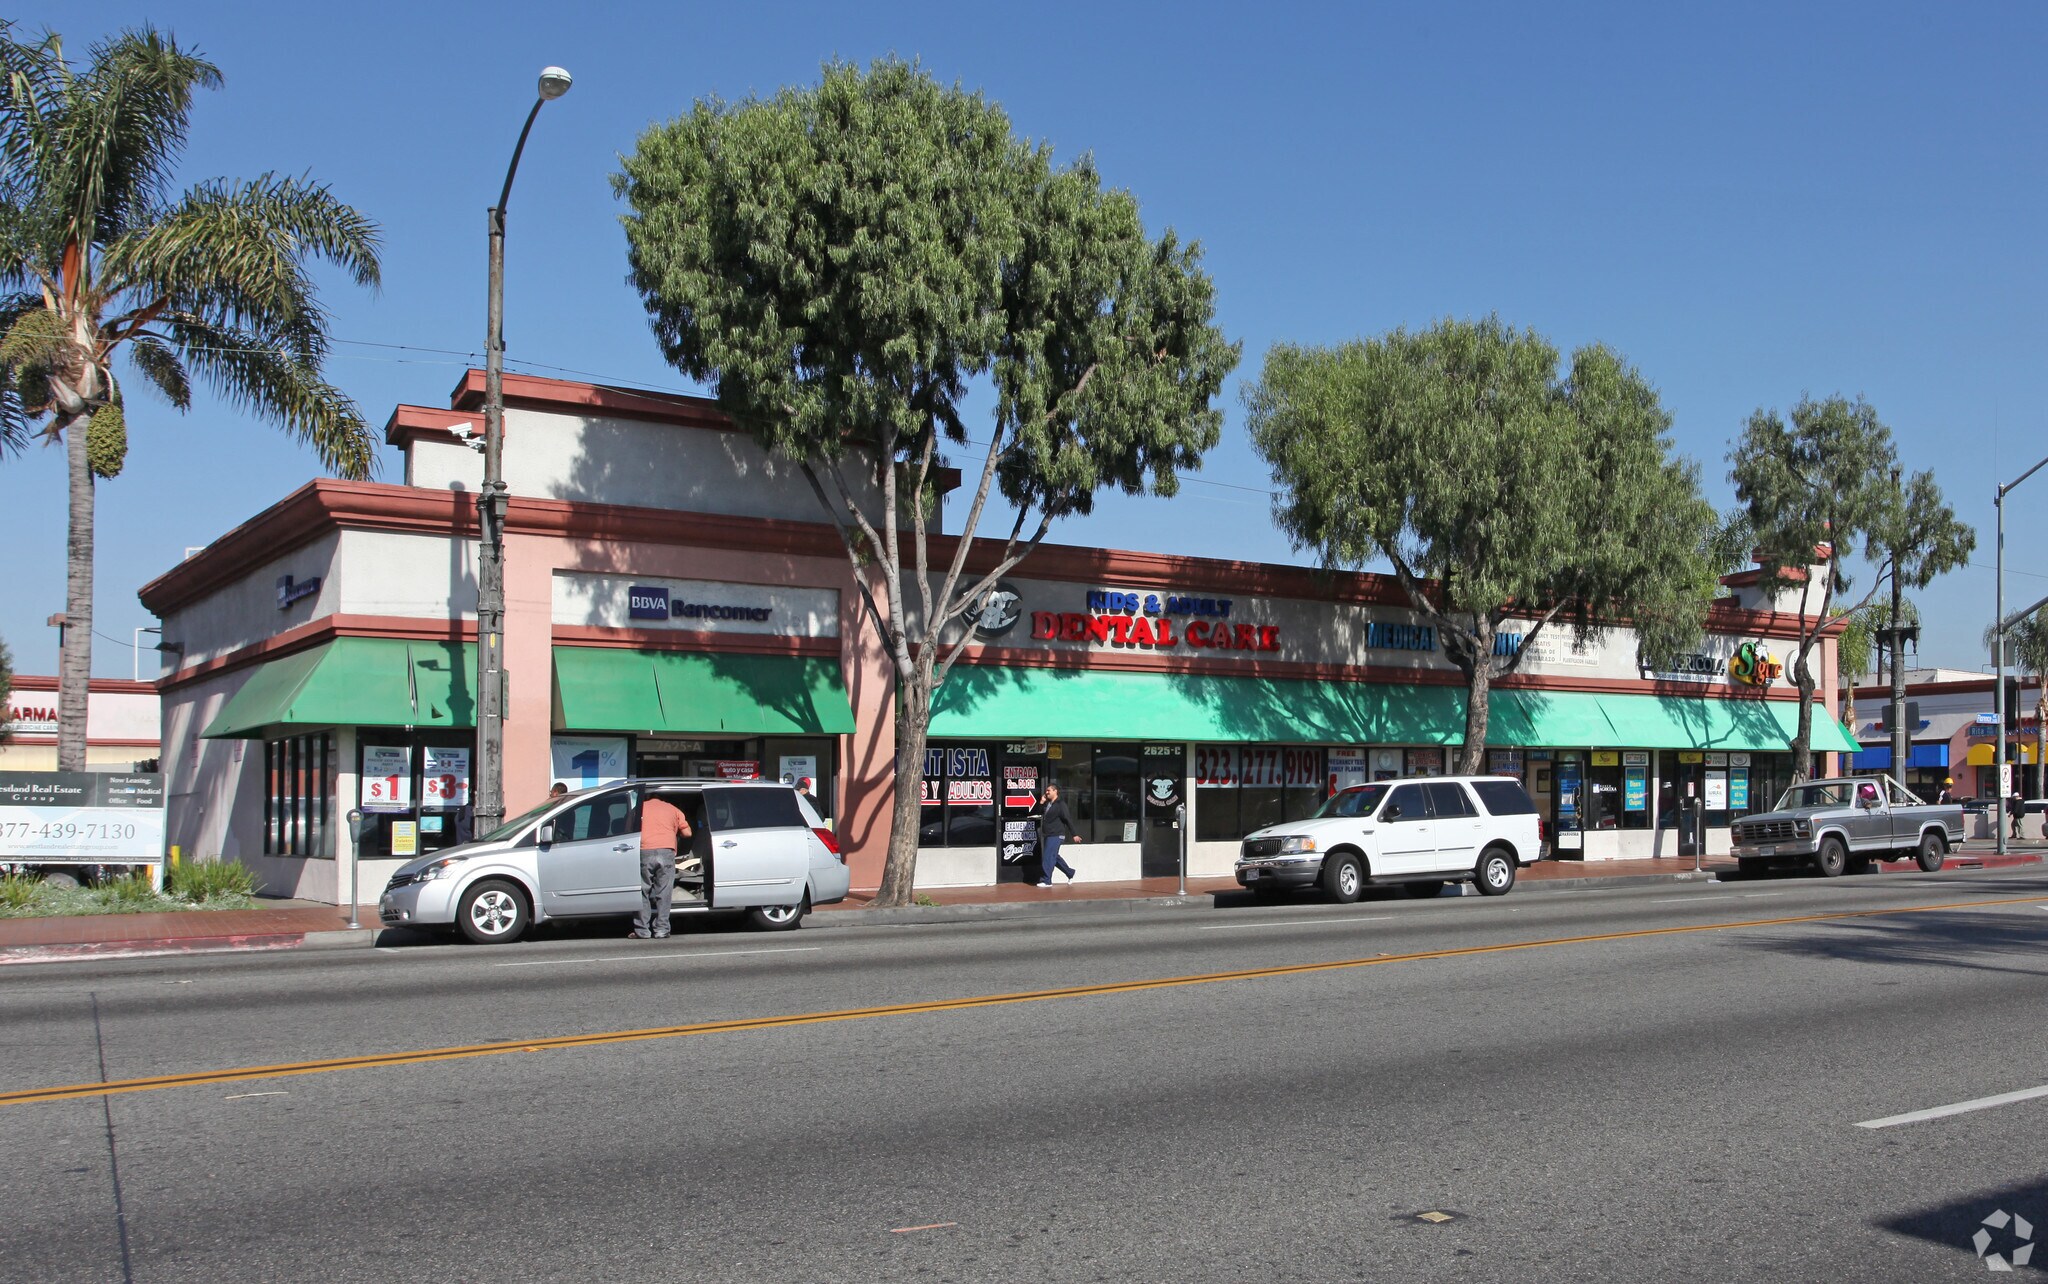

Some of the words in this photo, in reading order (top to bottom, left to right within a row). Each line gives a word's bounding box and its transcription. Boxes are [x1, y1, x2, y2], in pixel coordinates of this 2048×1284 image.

[632, 596, 667, 610] BBVA
[671, 600, 772, 621] Bancomer
[1087, 590, 1139, 612] KIDS
[1144, 594, 1161, 613] &
[1165, 597, 1232, 617] ADULT
[1031, 610, 1178, 646] DENTAL
[1185, 620, 1280, 651] CARE
[1367, 622, 1440, 652] MEDICAL
[1668, 654, 1729, 675] AGRICOLA
[1735, 642, 1783, 685] Sigue
[9, 707, 58, 721] ARMA
[1971, 727, 1985, 735] Rita
[656, 742, 701, 751] 2625-A
[1006, 744, 1026, 753] 262
[1144, 746, 1181, 755] 2625-C
[1003, 766, 1039, 779] ENTRADA
[126, 777, 151, 785] Leasing:
[0, 785, 30, 793] estland
[32, 785, 51, 793] Real
[54, 785, 82, 794] Estate
[931, 781, 939, 799] Y
[948, 780, 993, 799] ADULTOS
[12, 794, 55, 802] Group
